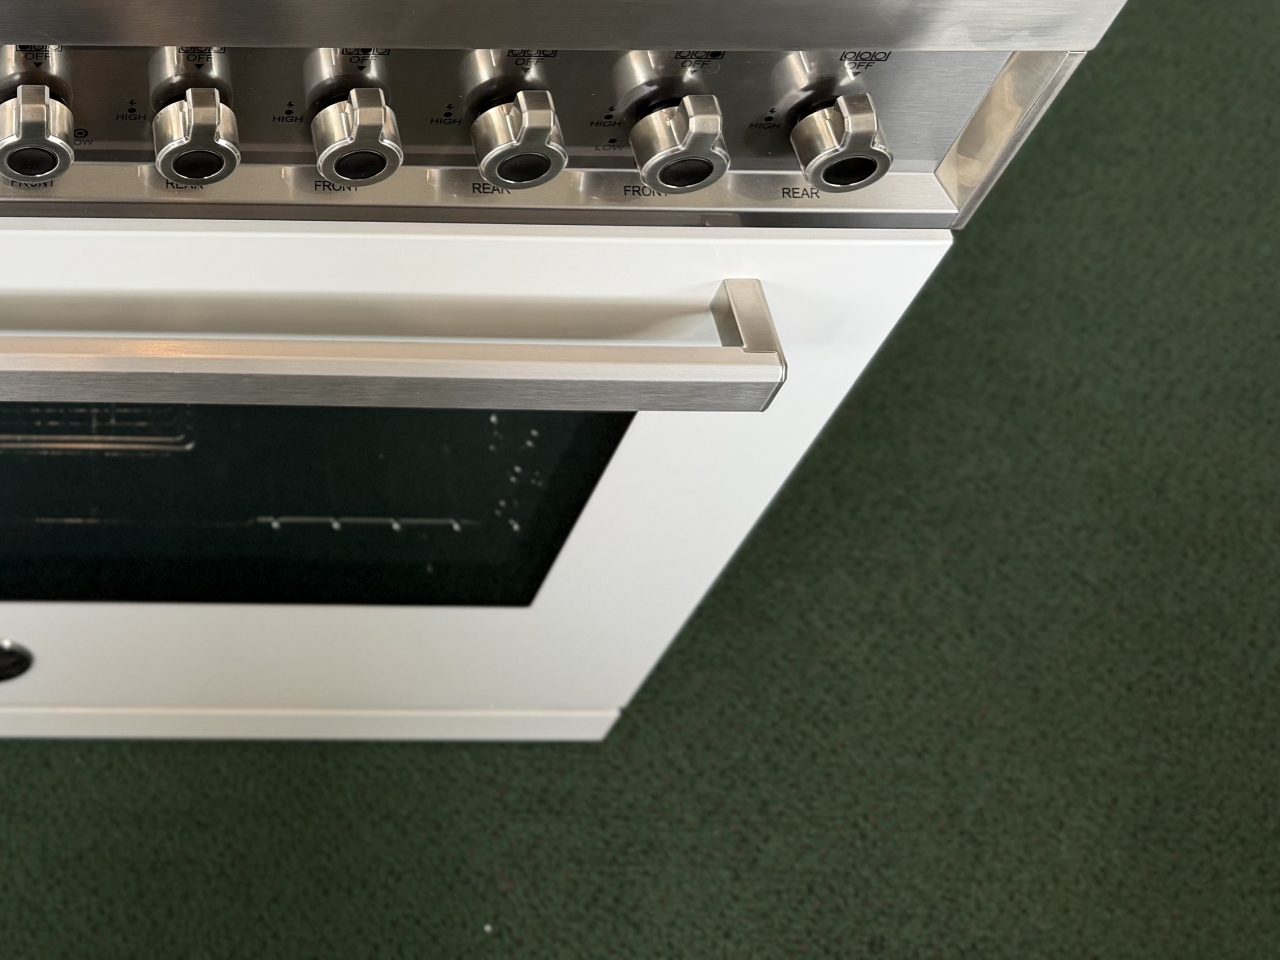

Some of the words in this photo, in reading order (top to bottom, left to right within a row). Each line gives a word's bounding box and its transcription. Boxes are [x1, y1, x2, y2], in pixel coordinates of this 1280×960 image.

[24, 52, 52, 60] OFF
[186, 53, 213, 62] OFF
[349, 56, 380, 64] OFF
[515, 57, 545, 66] OFF
[681, 60, 711, 68] OFF
[846, 61, 876, 70] OFF
[272, 115, 304, 123] HIGH
[589, 120, 622, 128] HIGH
[748, 122, 781, 130] HIGH
[781, 187, 820, 199] REAR
